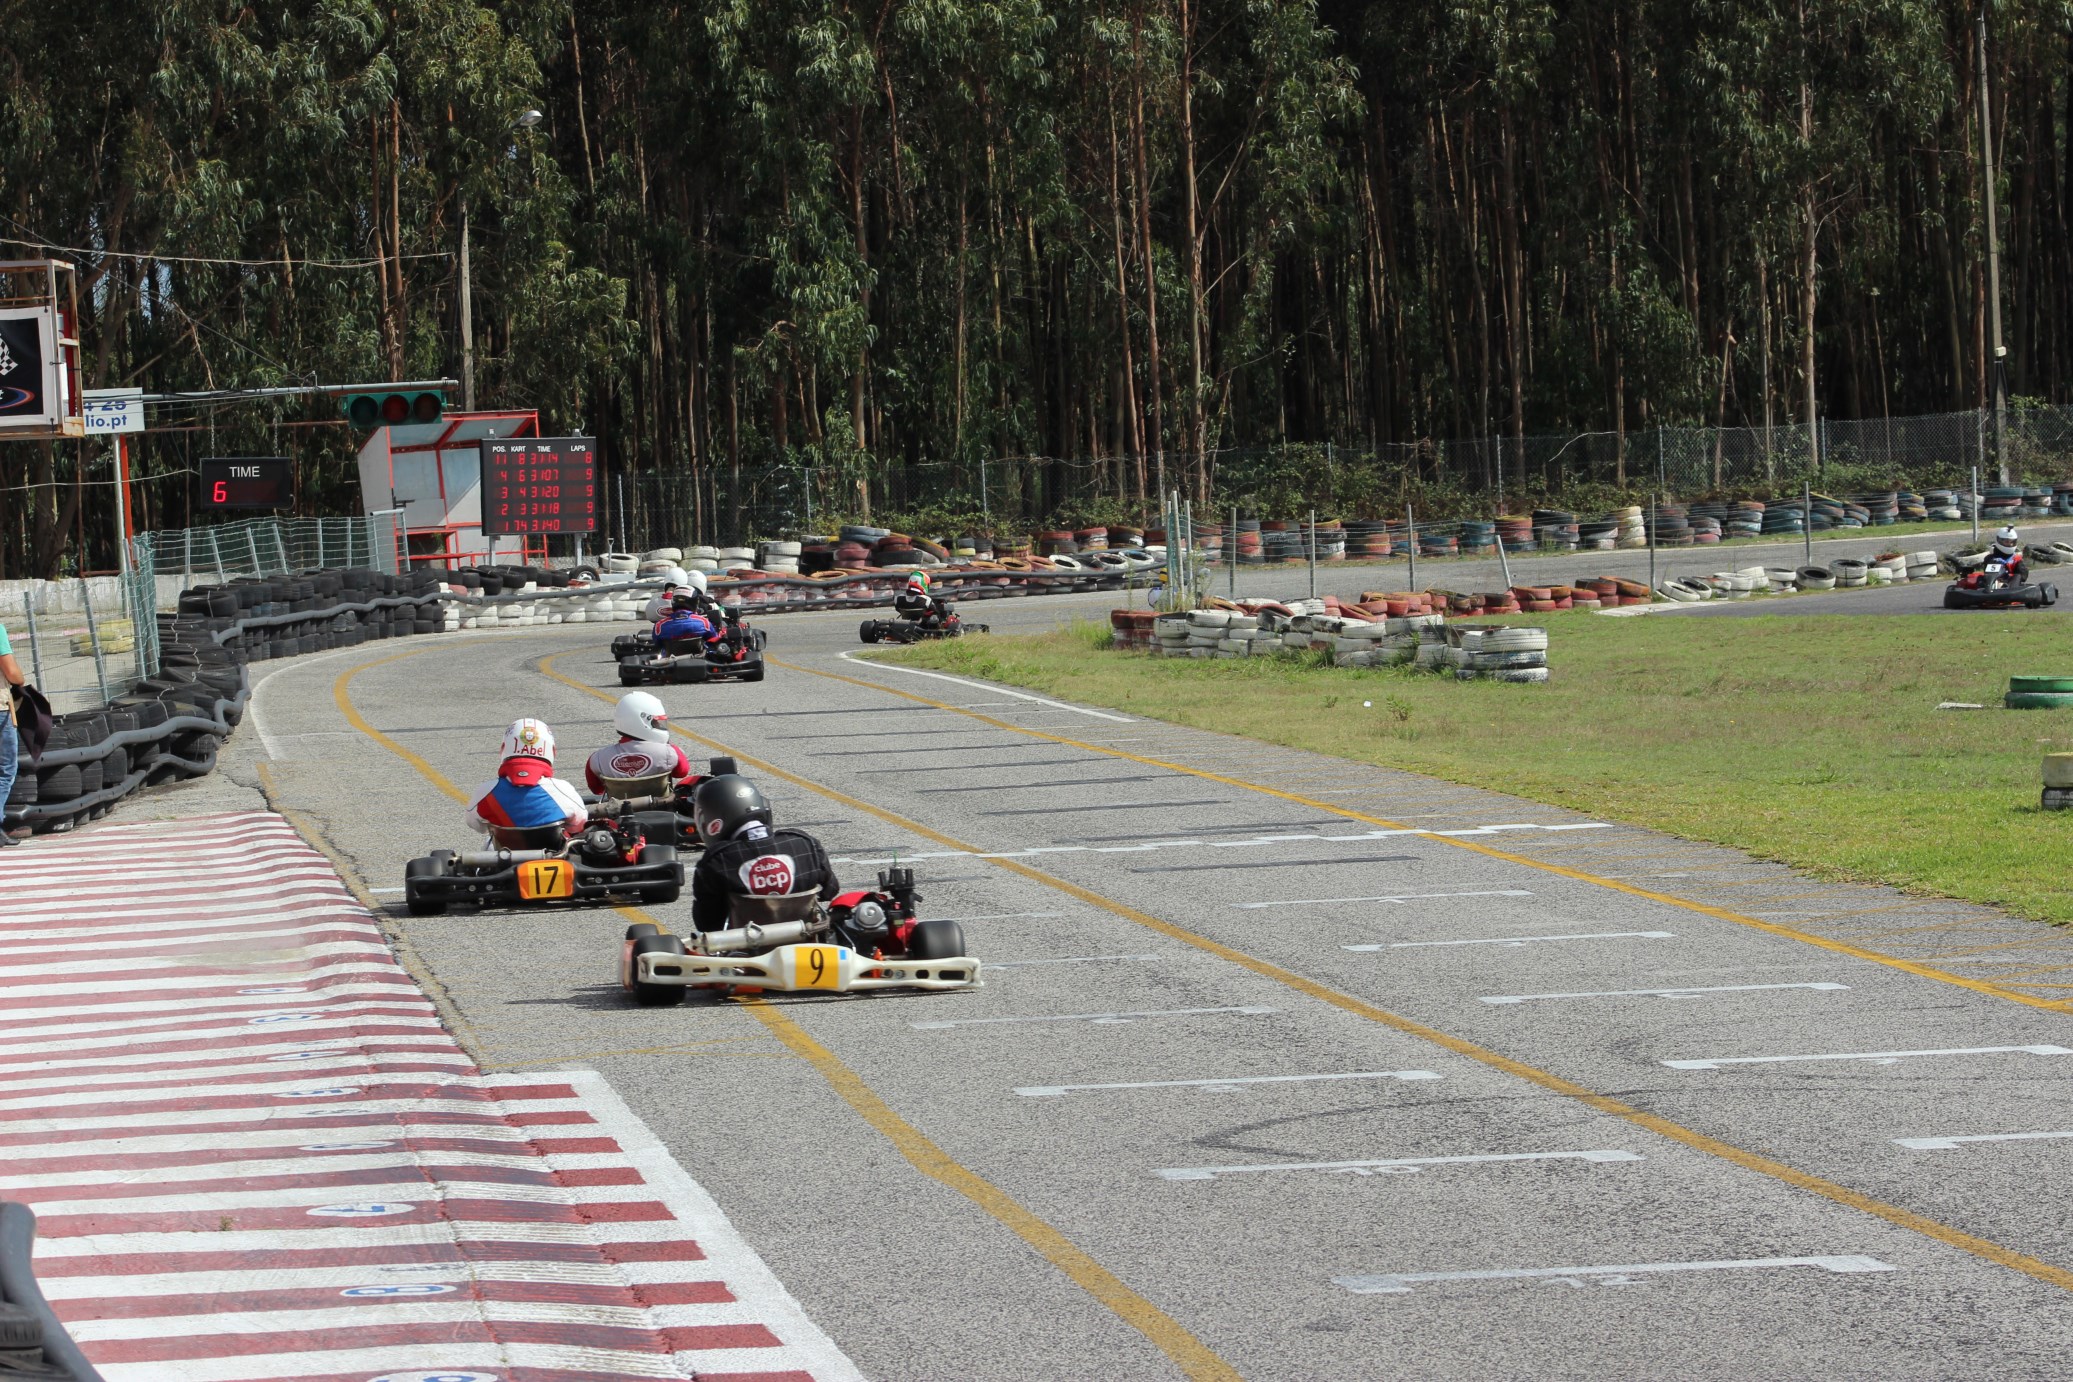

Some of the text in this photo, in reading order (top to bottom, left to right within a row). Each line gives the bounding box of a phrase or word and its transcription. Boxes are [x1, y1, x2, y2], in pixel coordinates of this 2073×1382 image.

[492, 444, 586, 453] POS. KART TIME LAPS
[518, 452, 526, 465] 8
[585, 451, 593, 464] 8
[228, 465, 261, 478] TIME
[500, 470, 508, 481] 4
[519, 469, 526, 482] 6
[586, 467, 593, 481] 9
[213, 481, 228, 503] 6
[501, 486, 509, 499] 3
[519, 486, 527, 498] 4
[586, 484, 593, 497] 9
[501, 503, 509, 516] 2
[520, 503, 527, 515] 3
[586, 501, 593, 514] 9
[513, 519, 528, 531] 74
[587, 517, 594, 530] 9
[754, 862, 781, 873] clube
[534, 865, 559, 895] 17
[752, 871, 789, 889] bcp
[810, 948, 824, 985] 9
